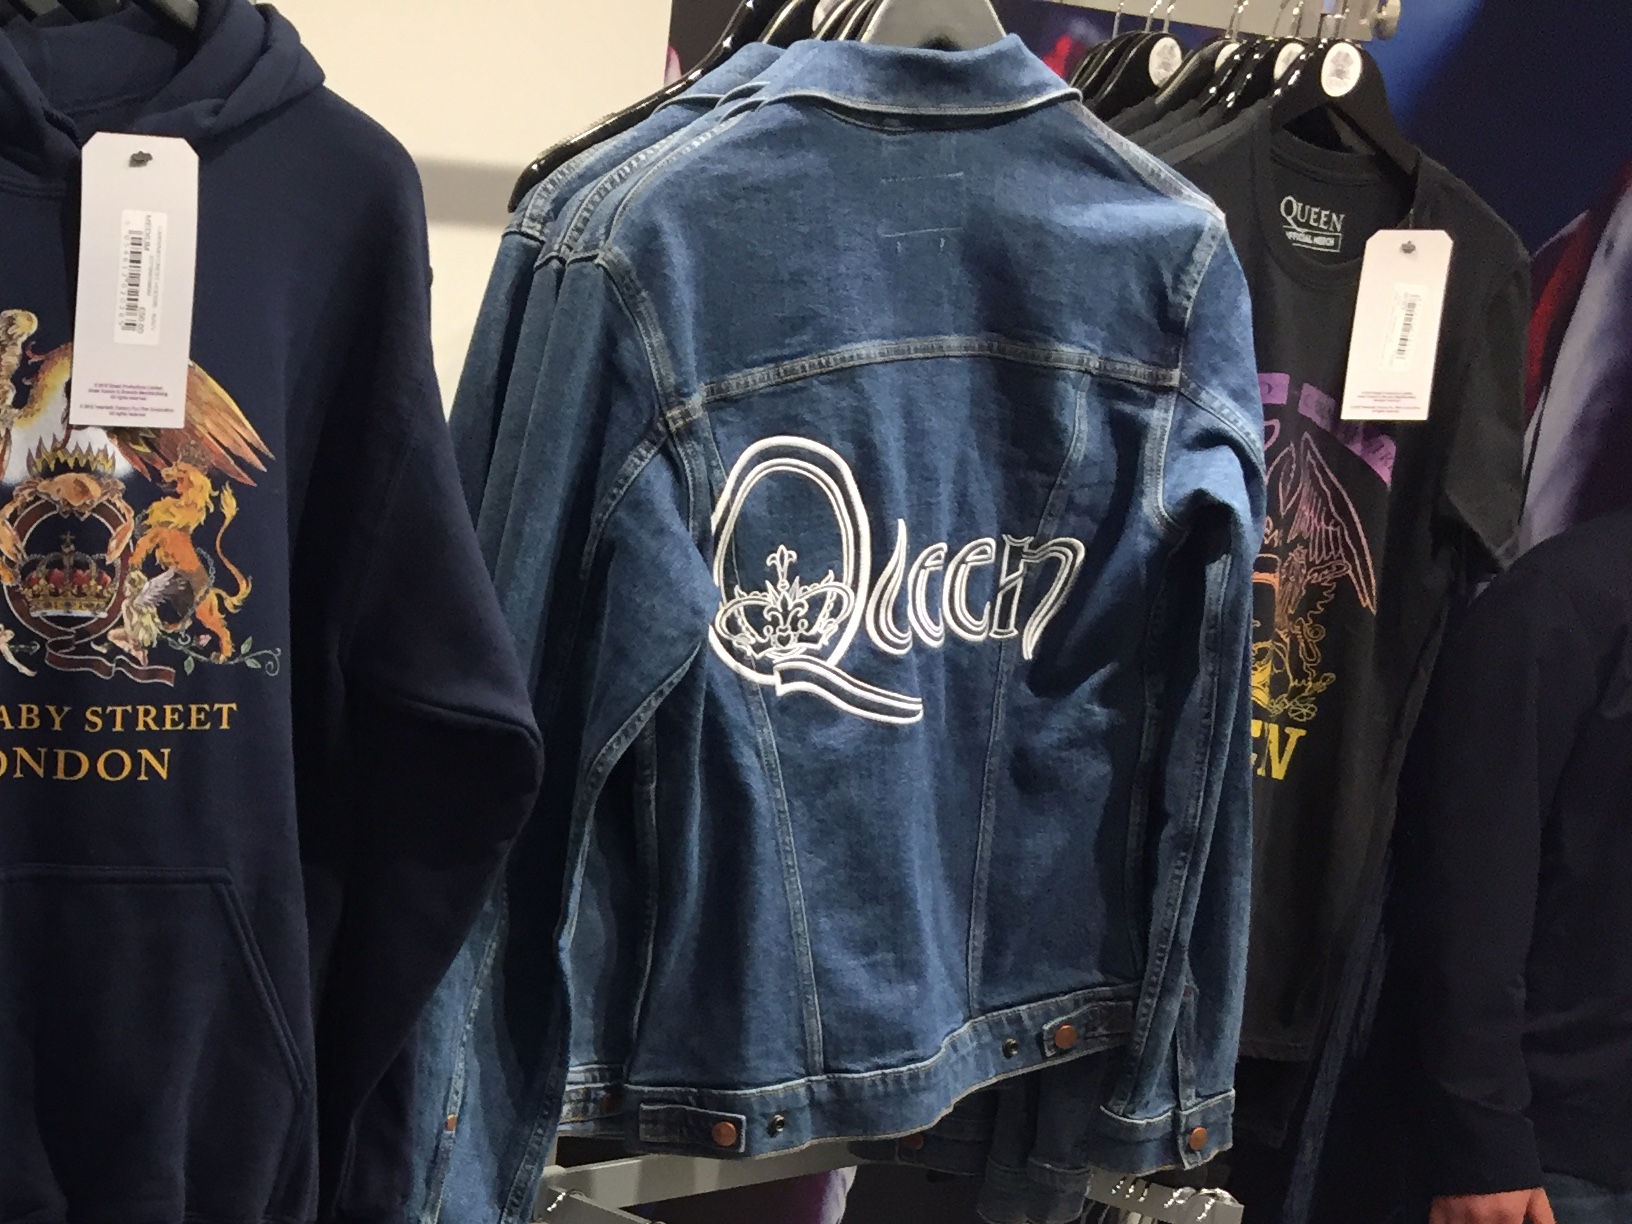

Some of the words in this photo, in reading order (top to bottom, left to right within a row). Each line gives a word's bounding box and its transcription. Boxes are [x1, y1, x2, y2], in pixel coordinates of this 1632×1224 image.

[1279, 194, 1346, 234] QUEEN
[707, 434, 1086, 726] Queen
[83, 702, 239, 733] STREET
